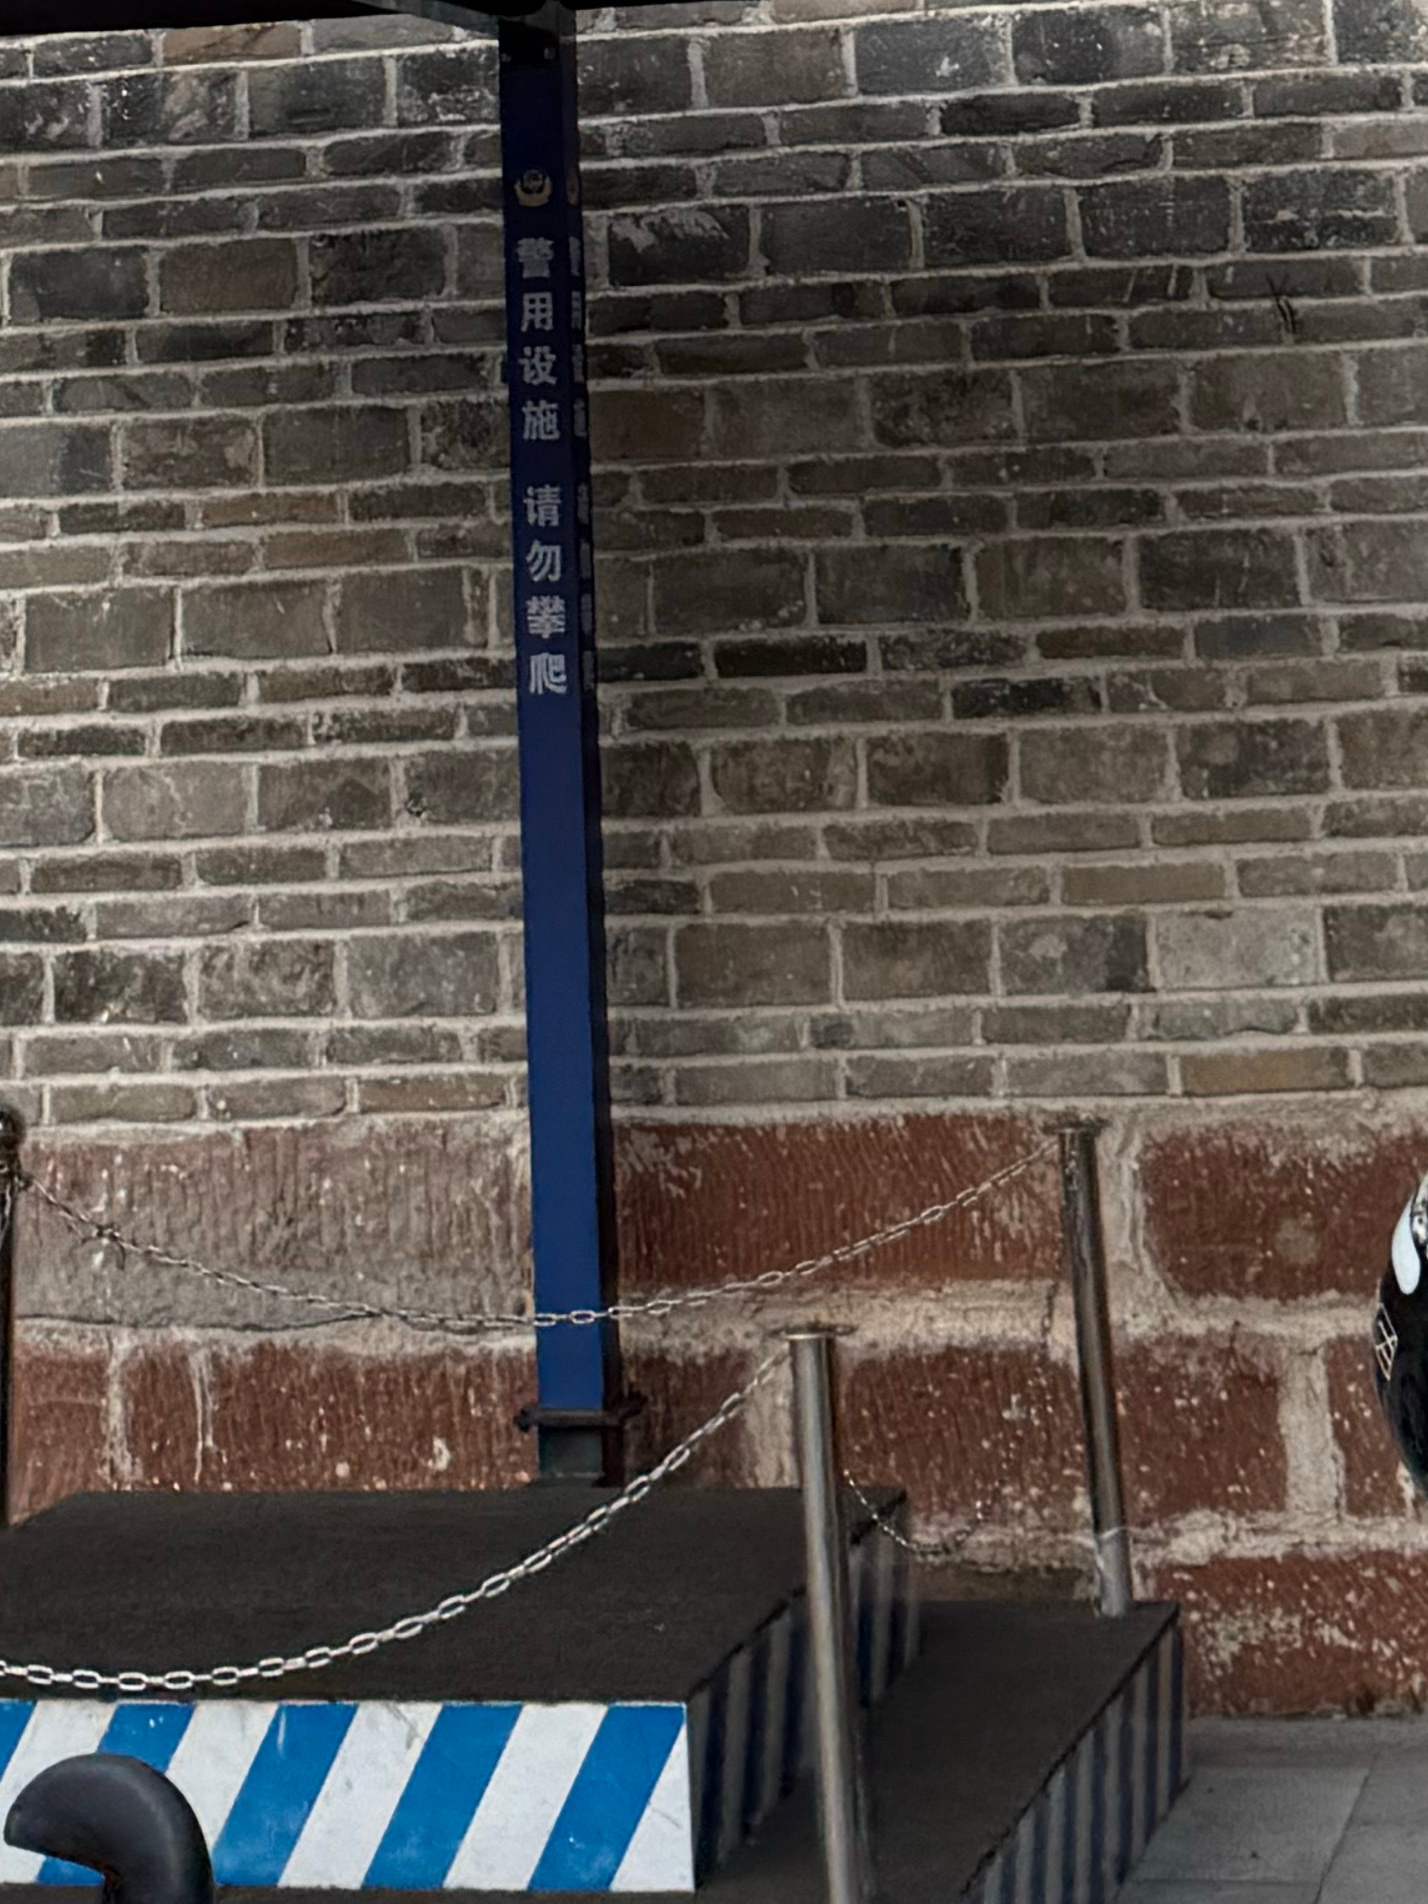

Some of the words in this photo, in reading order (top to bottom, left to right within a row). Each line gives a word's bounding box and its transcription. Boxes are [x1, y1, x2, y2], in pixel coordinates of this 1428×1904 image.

[516, 237, 561, 442] 警用设施
[523, 484, 569, 696] 请勿攀爬
